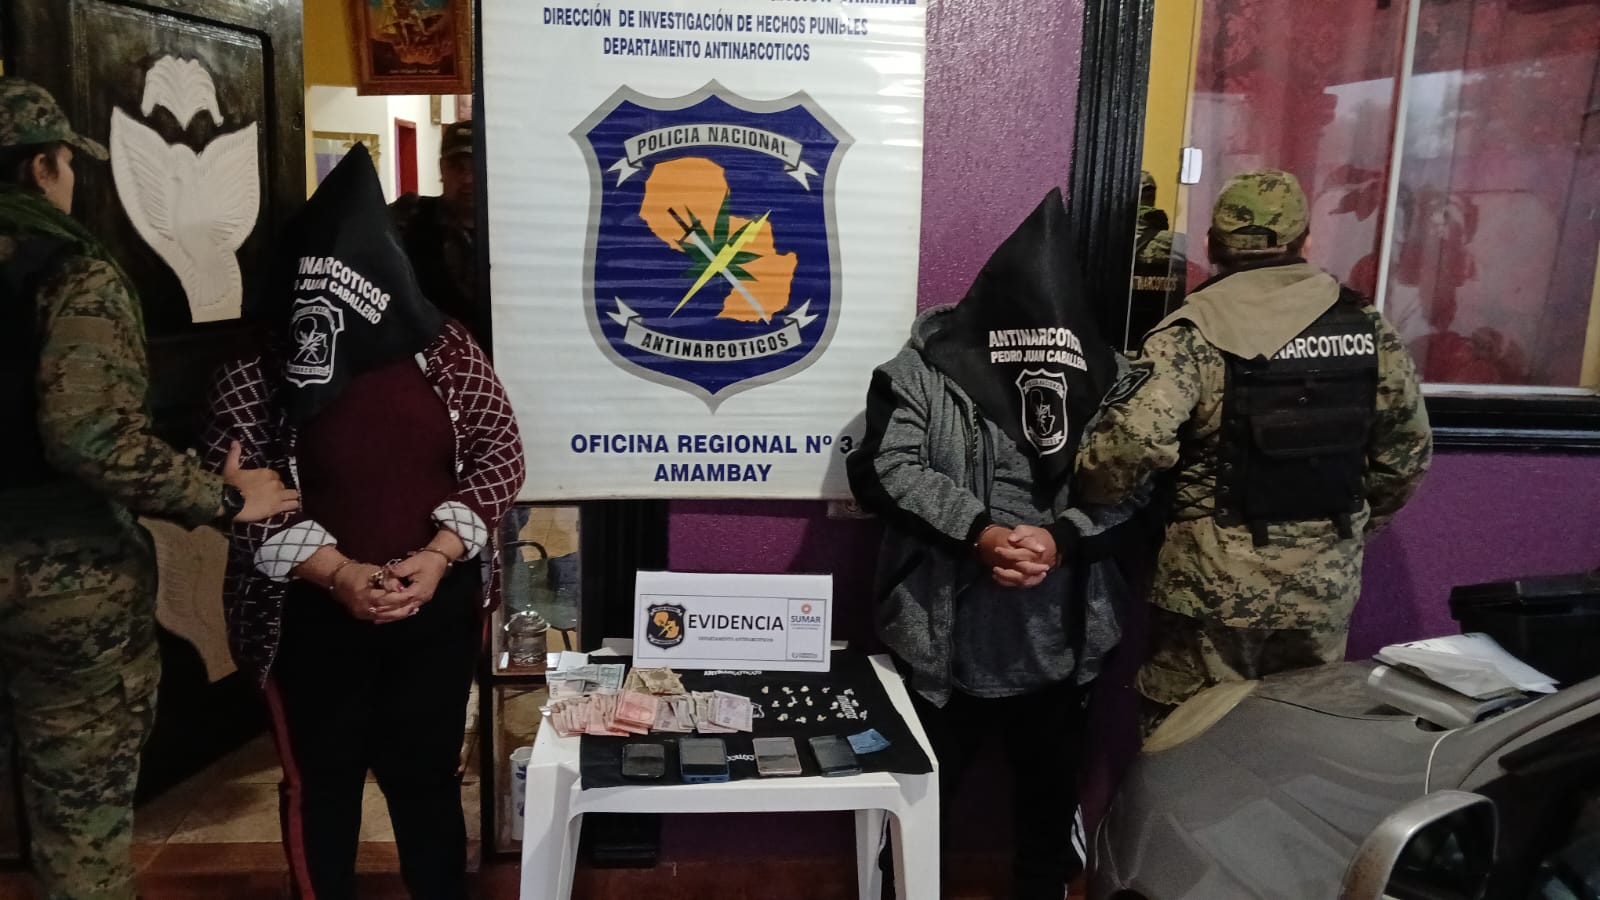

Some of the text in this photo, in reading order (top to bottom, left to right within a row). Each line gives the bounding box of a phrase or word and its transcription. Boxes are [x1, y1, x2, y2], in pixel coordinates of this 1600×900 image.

[543, 4, 868, 36] DIRECCIÓN DE INVESTIGACIÓN DE HECHOS PUNIBLES
[603, 37, 810, 61] DEPARTAMENTO ANTINARCOTICOS
[637, 126, 789, 158] POLICIA NACIONAL
[298, 256, 391, 312] INARCOTICOS
[329, 281, 382, 326] CABALLERO
[641, 331, 789, 359] ANTINARCOTICOS
[988, 327, 1084, 356] ANTINARCOTI
[990, 350, 1023, 364] PEDRO
[1023, 350, 1046, 362] JUAN
[571, 434, 669, 454] OFICINA
[677, 434, 797, 454] REGIONAL
[839, 435, 853, 454] 3
[654, 463, 773, 482] AMAMBAY
[688, 614, 784, 630] EVIDENCIA
[790, 614, 821, 624] SUMAR
